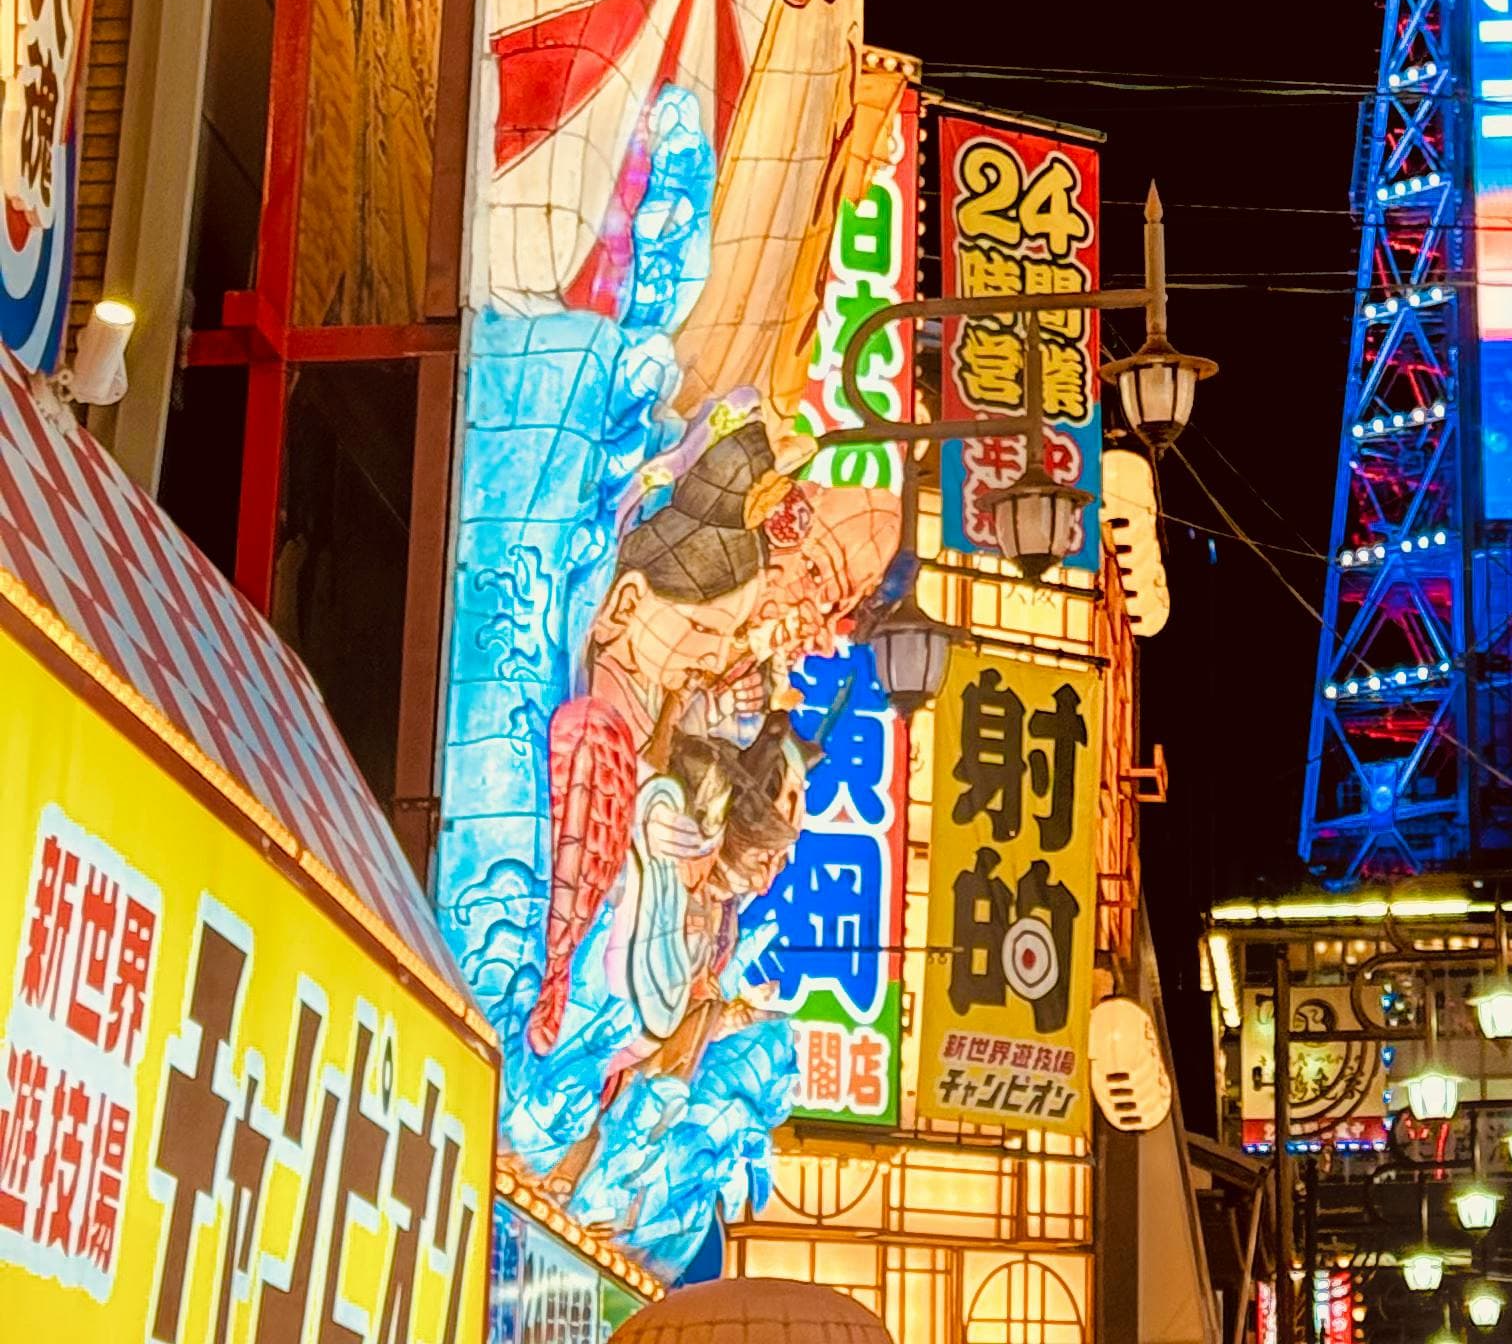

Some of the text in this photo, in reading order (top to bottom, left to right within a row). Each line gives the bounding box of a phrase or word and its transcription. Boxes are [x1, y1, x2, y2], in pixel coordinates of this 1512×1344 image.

[957, 142, 1089, 260] 24
[958, 244, 1087, 340] 時間
[956, 324, 1088, 422] 営業
[949, 667, 1088, 1034] 射的
[20, 832, 157, 1068] 新世界
[793, 1030, 883, 1107] 閣店
[939, 1069, 1075, 1119] チャンピオン
[943, 1034, 1076, 1076] 新世界遊技場
[0, 1040, 132, 1276] 遊技場
